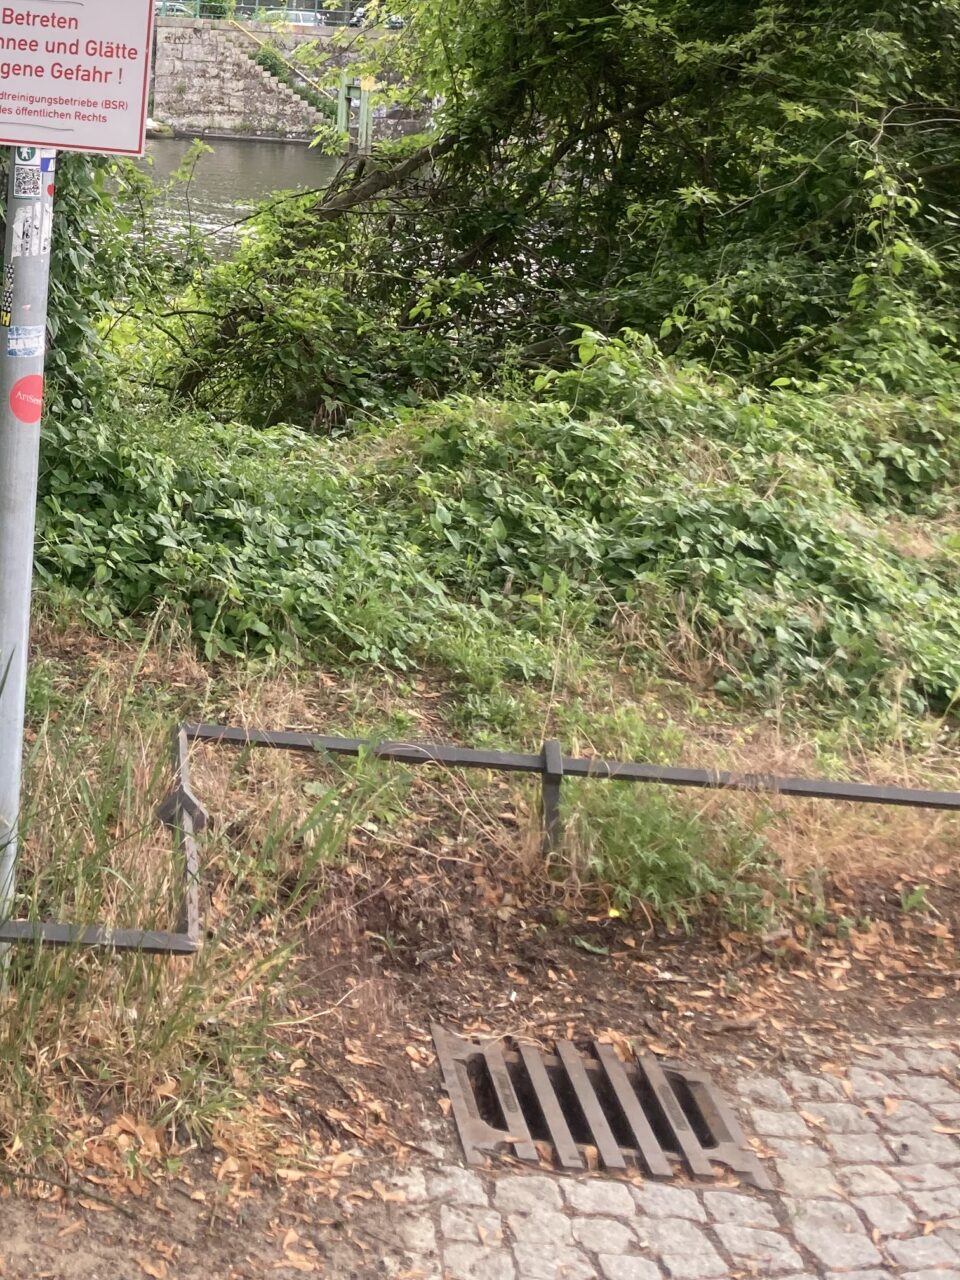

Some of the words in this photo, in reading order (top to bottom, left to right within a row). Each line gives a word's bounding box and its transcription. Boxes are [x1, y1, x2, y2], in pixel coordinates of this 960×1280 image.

[2, 8, 79, 30] Betreten
[45, 39, 79, 55] und
[85, 40, 138, 60] Glätte
[51, 62, 113, 84] Gefahr
[118, 67, 122, 84] !
[15, 106, 71, 120] öffentlichen
[74, 111, 107, 123] Rechts
[101, 99, 128, 111] (BSR)
